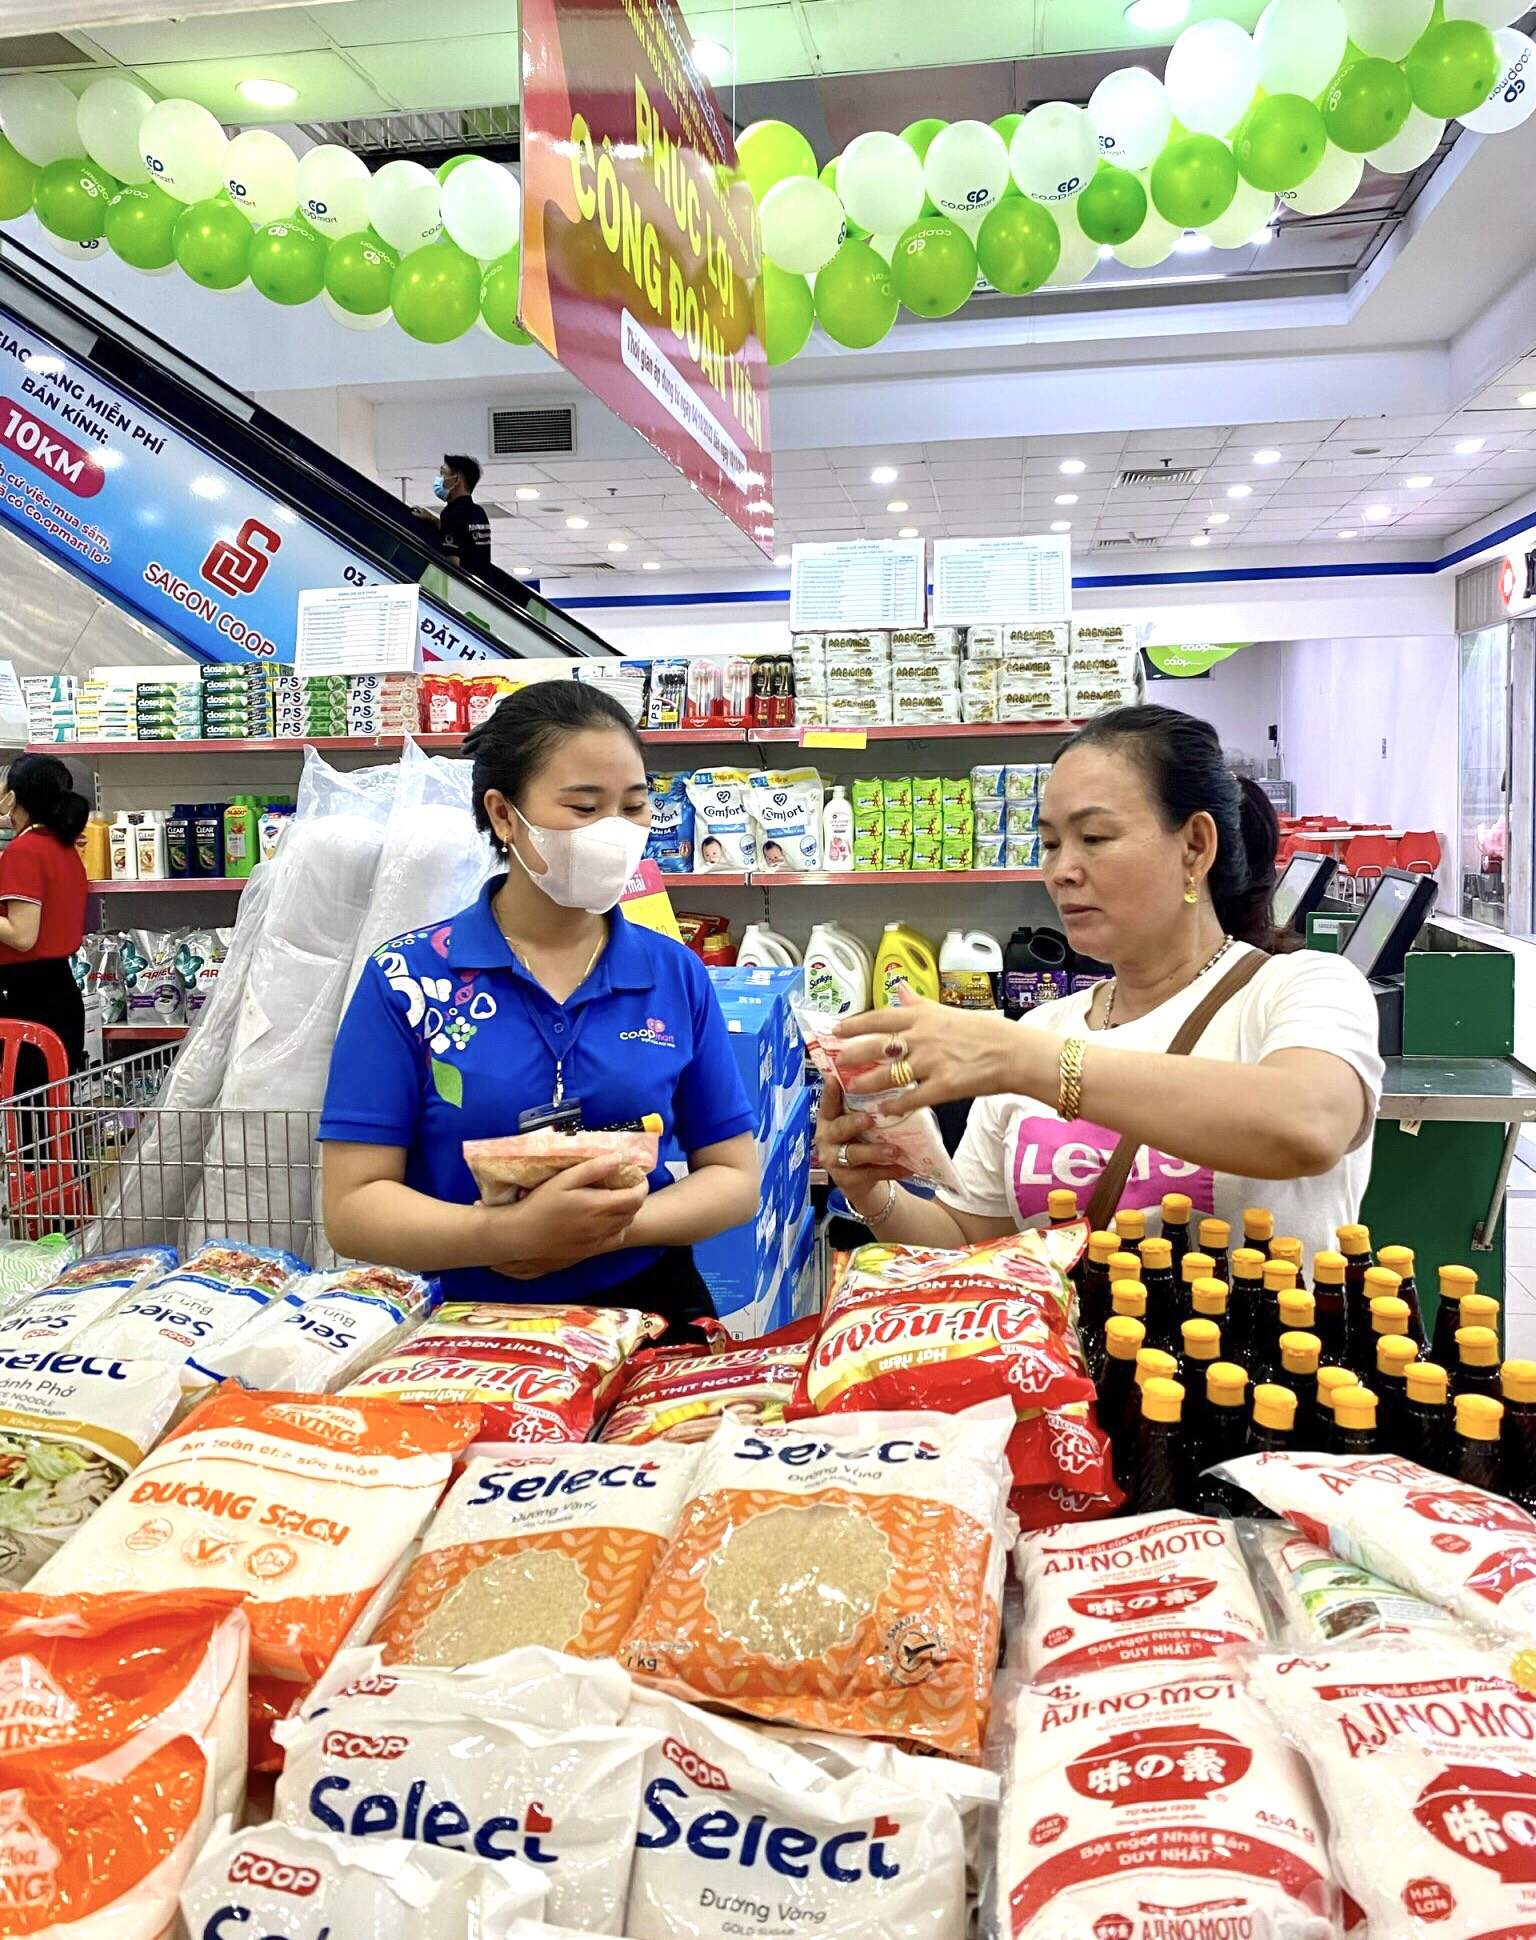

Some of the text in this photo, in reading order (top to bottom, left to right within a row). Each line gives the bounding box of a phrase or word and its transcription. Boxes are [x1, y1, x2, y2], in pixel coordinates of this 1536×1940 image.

[635, 73, 700, 257] PHÚC
[706, 210, 735, 318] LỢI
[570, 113, 762, 453] CÔNG ĐOÀN VIÊN
[21, 376, 109, 445] BÁN KÍNH:
[86, 394, 168, 455] MIỄN PHÍ
[3, 409, 85, 484] 10KM
[7, 471, 111, 552] cứ việc mua sắm,
[7, 490, 24, 509] có
[25, 503, 90, 557] Co.opmart
[342, 565, 368, 587] 03
[145, 563, 218, 622] SAIGON
[217, 615, 276, 658] CO.OP
[420, 617, 461, 650] ĐẶT
[167, 827, 186, 835] CLEAR
[141, 966, 176, 980] ARIEL
[817, 1299, 1042, 1369] Aji-ngon
[262, 1407, 359, 1443] SAVING
[130, 1480, 257, 1521] ĐƯỜNG
[467, 1459, 659, 1506] Select
[1043, 1529, 1226, 1576] AJI-NO-MOTO
[636, 1656, 659, 1673] kg
[1119, 1648, 1150, 1661] DUY
[327, 1733, 408, 1758] COOP
[666, 1740, 727, 1788] COOP
[1087, 1746, 1227, 1793] 味の素
[310, 1775, 558, 1864] Select
[636, 1778, 901, 1882] Select
[232, 1856, 318, 1894] COOP
[1118, 1845, 1211, 1866] DUY NHẤT
[700, 1888, 827, 1924] Đường Vàng
[722, 1921, 756, 1935] GOLD
